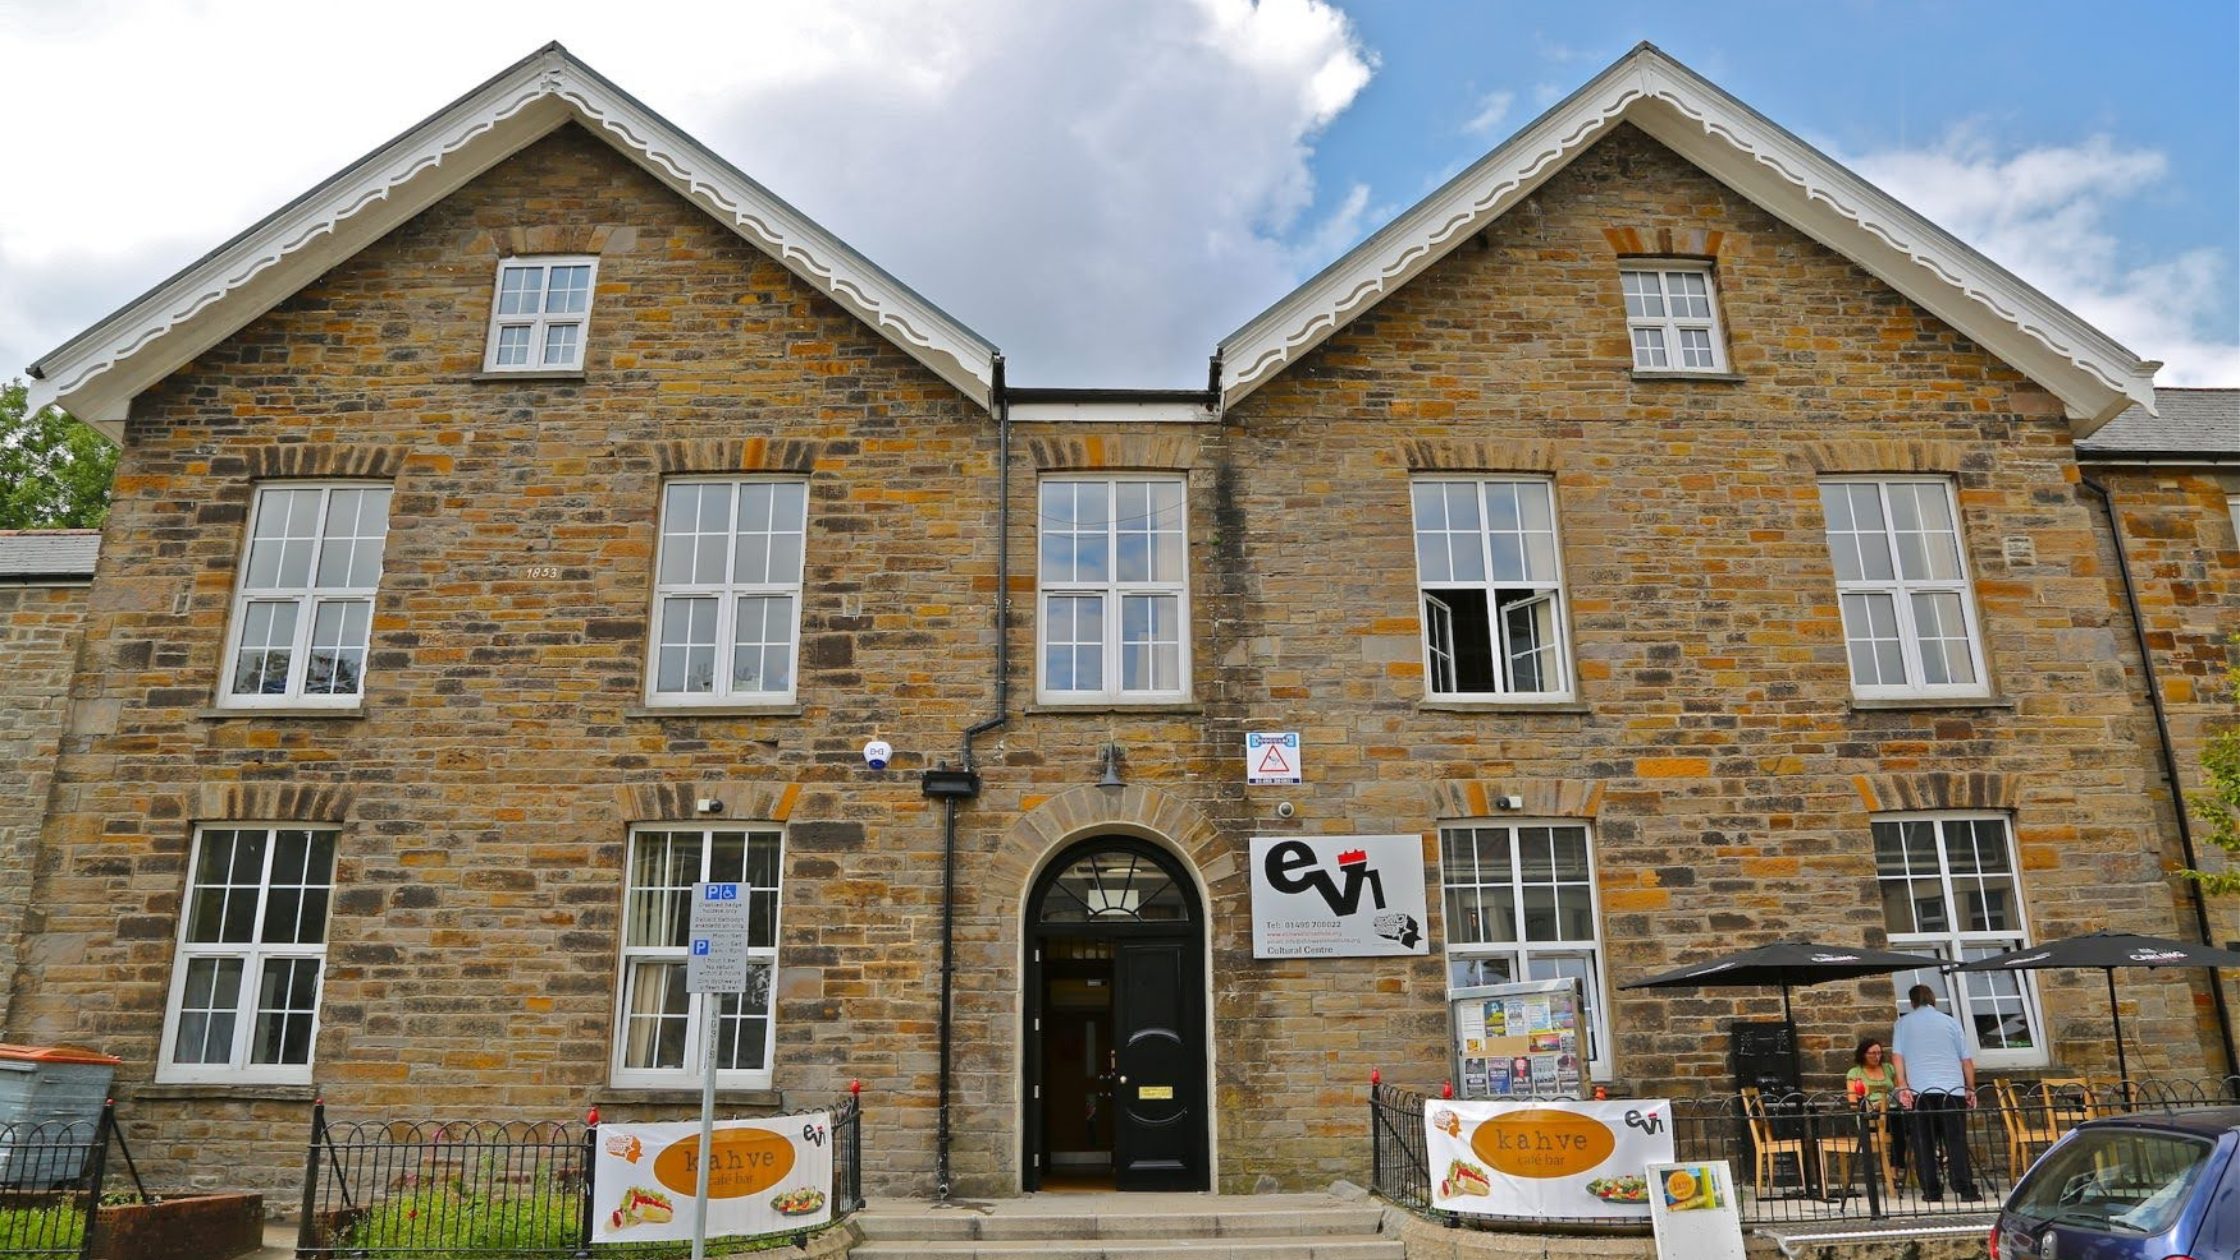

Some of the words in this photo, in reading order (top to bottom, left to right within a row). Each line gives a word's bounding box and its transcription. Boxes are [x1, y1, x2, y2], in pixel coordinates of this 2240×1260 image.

[526, 567, 558, 578] 1853
[707, 885, 719, 899] P
[1266, 921, 1281, 929] Tel:
[1267, 945, 1302, 955] Cultural
[1303, 945, 1334, 955] Centre
[1496, 1128, 1588, 1150] kahve
[684, 1149, 775, 1172] kahve
[1544, 1153, 1566, 1165] bar
[735, 1172, 754, 1184] bar
